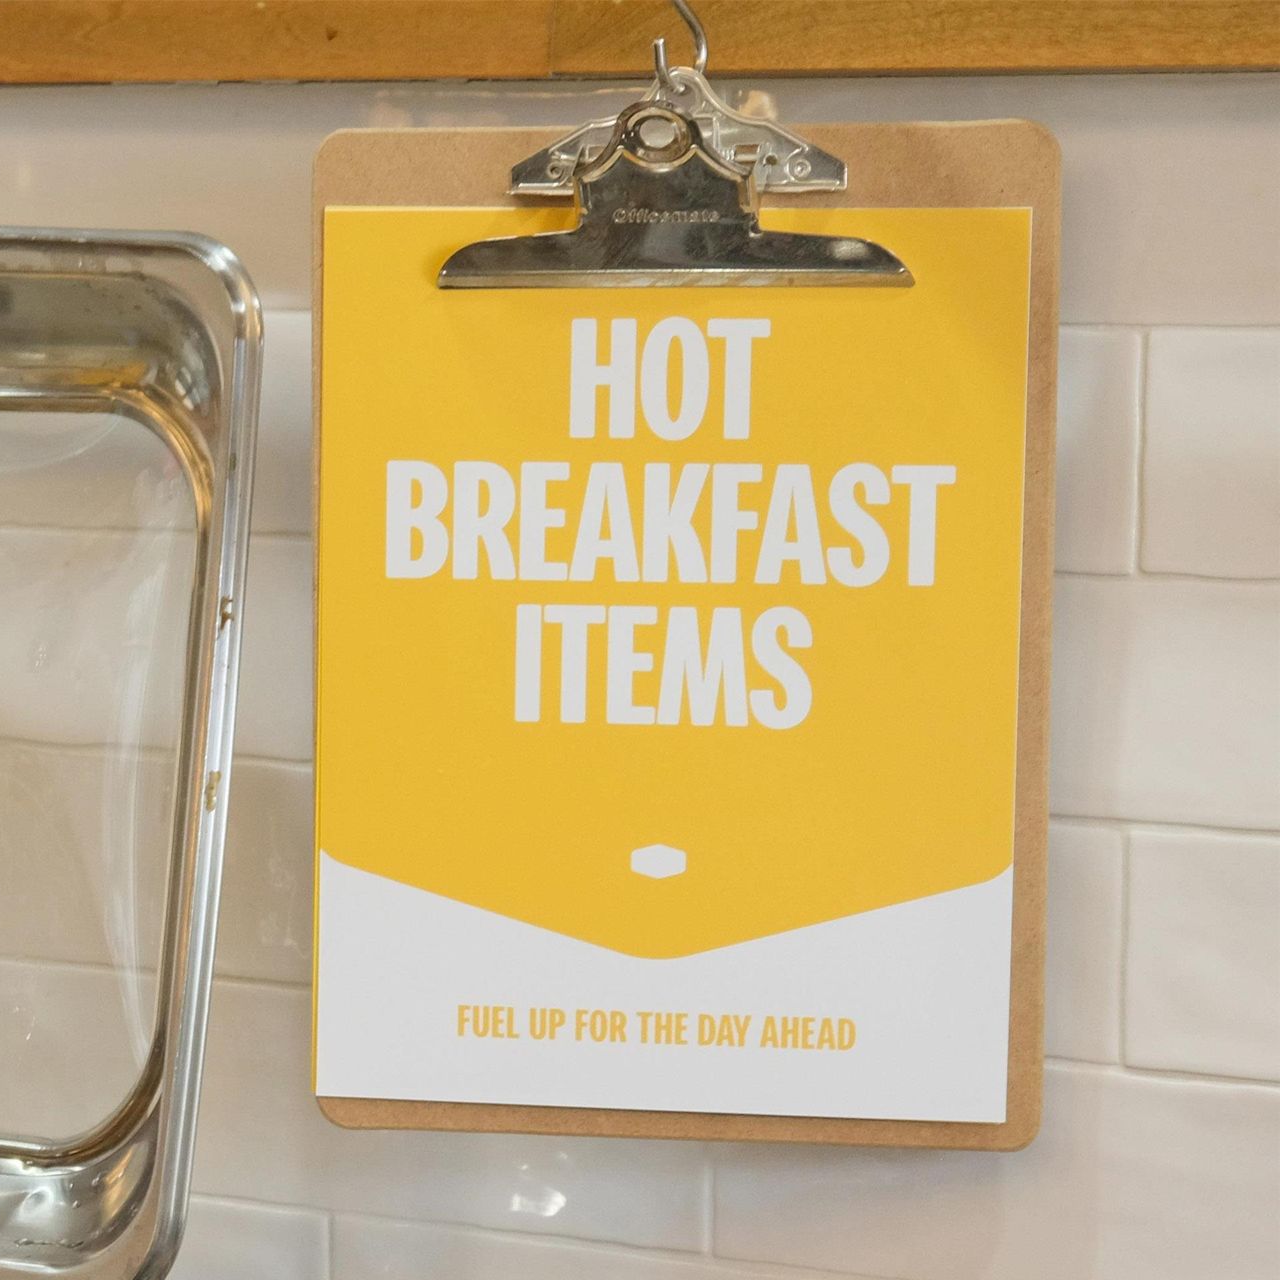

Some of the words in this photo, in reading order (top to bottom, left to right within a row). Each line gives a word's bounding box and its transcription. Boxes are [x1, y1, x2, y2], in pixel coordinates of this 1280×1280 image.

[568, 316, 772, 441] HOT
[384, 459, 957, 588] BREAKFAST
[513, 603, 814, 731] ITEMS
[456, 1004, 520, 1040] FUEL
[528, 1007, 567, 1041] UP
[574, 1009, 628, 1043] FOR
[636, 1011, 689, 1046] THE
[696, 1013, 753, 1048] DAY
[759, 1015, 857, 1052] AHEAD
